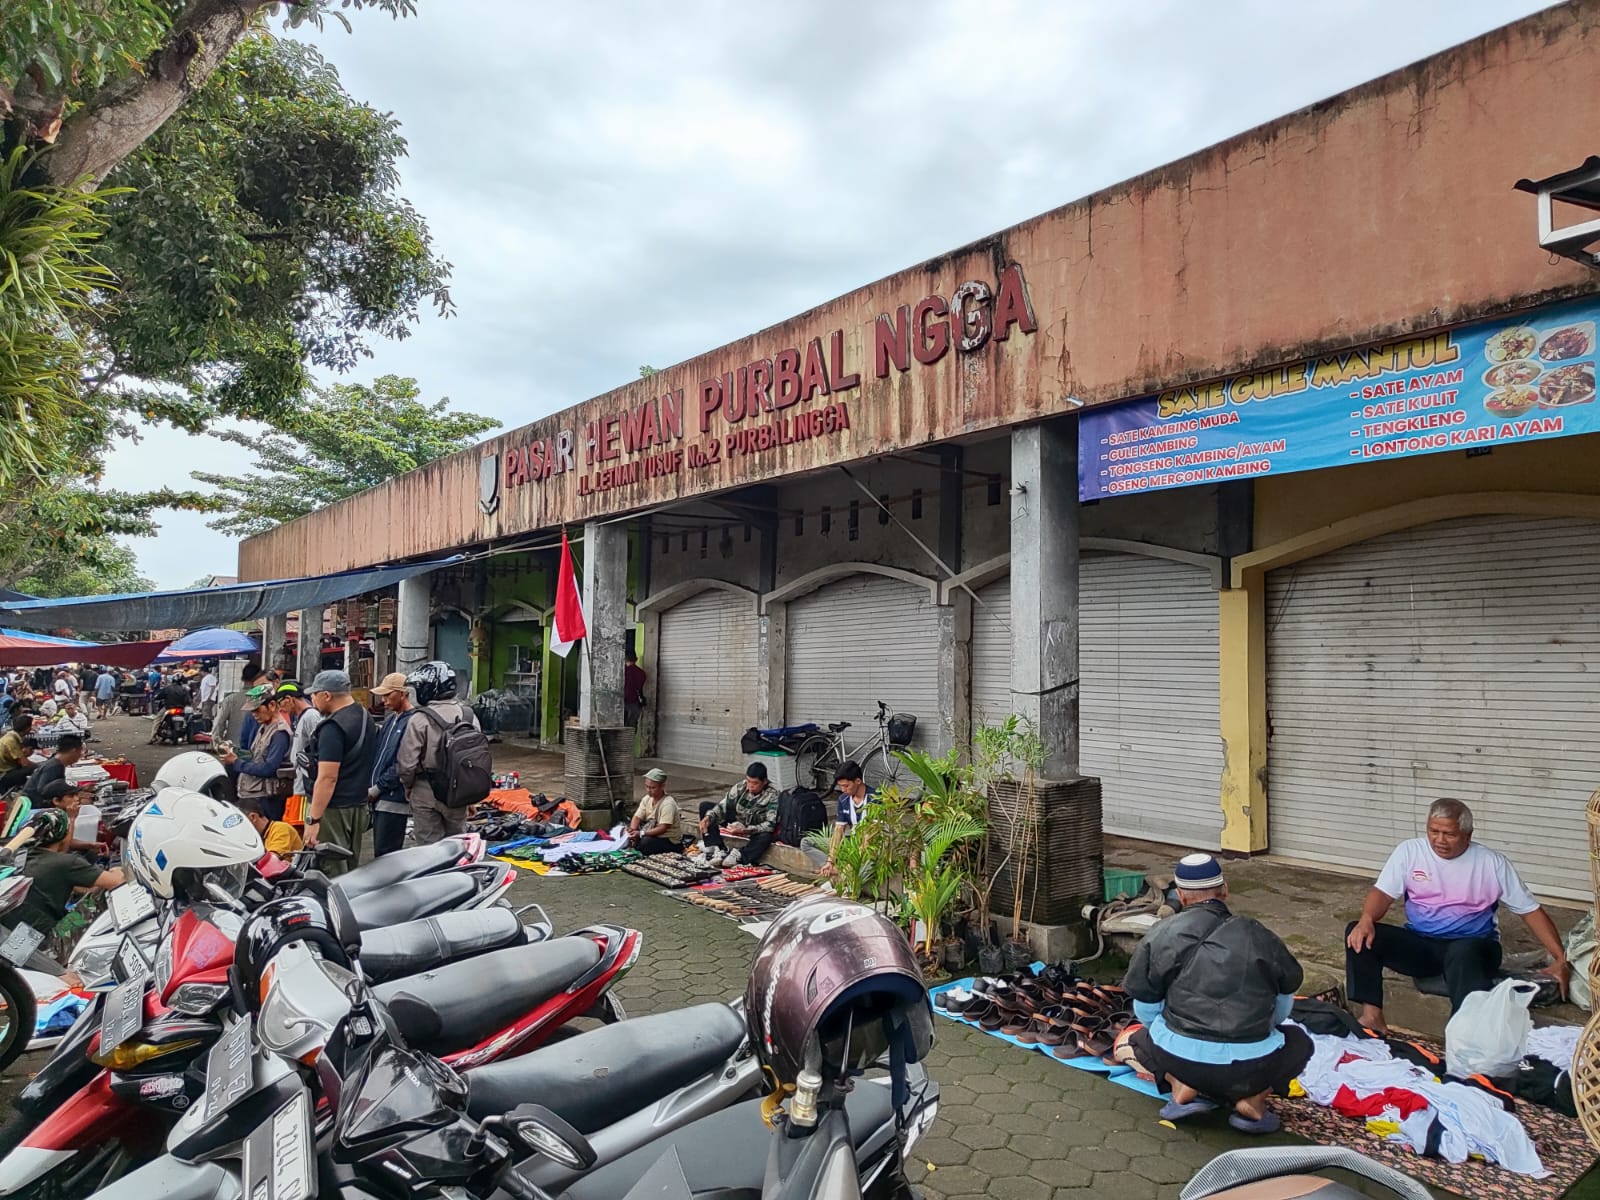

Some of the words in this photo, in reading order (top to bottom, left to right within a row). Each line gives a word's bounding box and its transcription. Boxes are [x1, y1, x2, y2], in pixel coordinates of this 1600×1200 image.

[1158, 380, 1227, 418] SATE
[1229, 362, 1308, 405] GULE
[1310, 331, 1460, 387] MANTUL
[1362, 380, 1405, 399] SATE
[1408, 369, 1463, 392] AYAM
[1363, 400, 1405, 418] SATE
[1407, 390, 1458, 411] KULIT
[504, 430, 574, 489] PASAR
[584, 388, 684, 466] HEWAN
[1109, 430, 1138, 445] SATE
[1140, 419, 1198, 440] KAMBING
[1199, 411, 1240, 430] MUDA
[1362, 410, 1466, 438] TENGKLENG
[1362, 433, 1448, 457] LONTONG
[1450, 426, 1496, 445] KARI
[1499, 415, 1563, 439] AYAM
[595, 461, 640, 492] LETNAN
[641, 449, 684, 481] YUSUF
[726, 402, 850, 458] PURBALINGGA
[1109, 446, 1138, 461] GULE
[1140, 436, 1198, 456] KAMBING
[1109, 458, 1173, 477] TONGSENG
[1109, 478, 1147, 493] OSENG
[1149, 469, 1204, 487] MERCON
[1205, 460, 1270, 480] KAMBING
